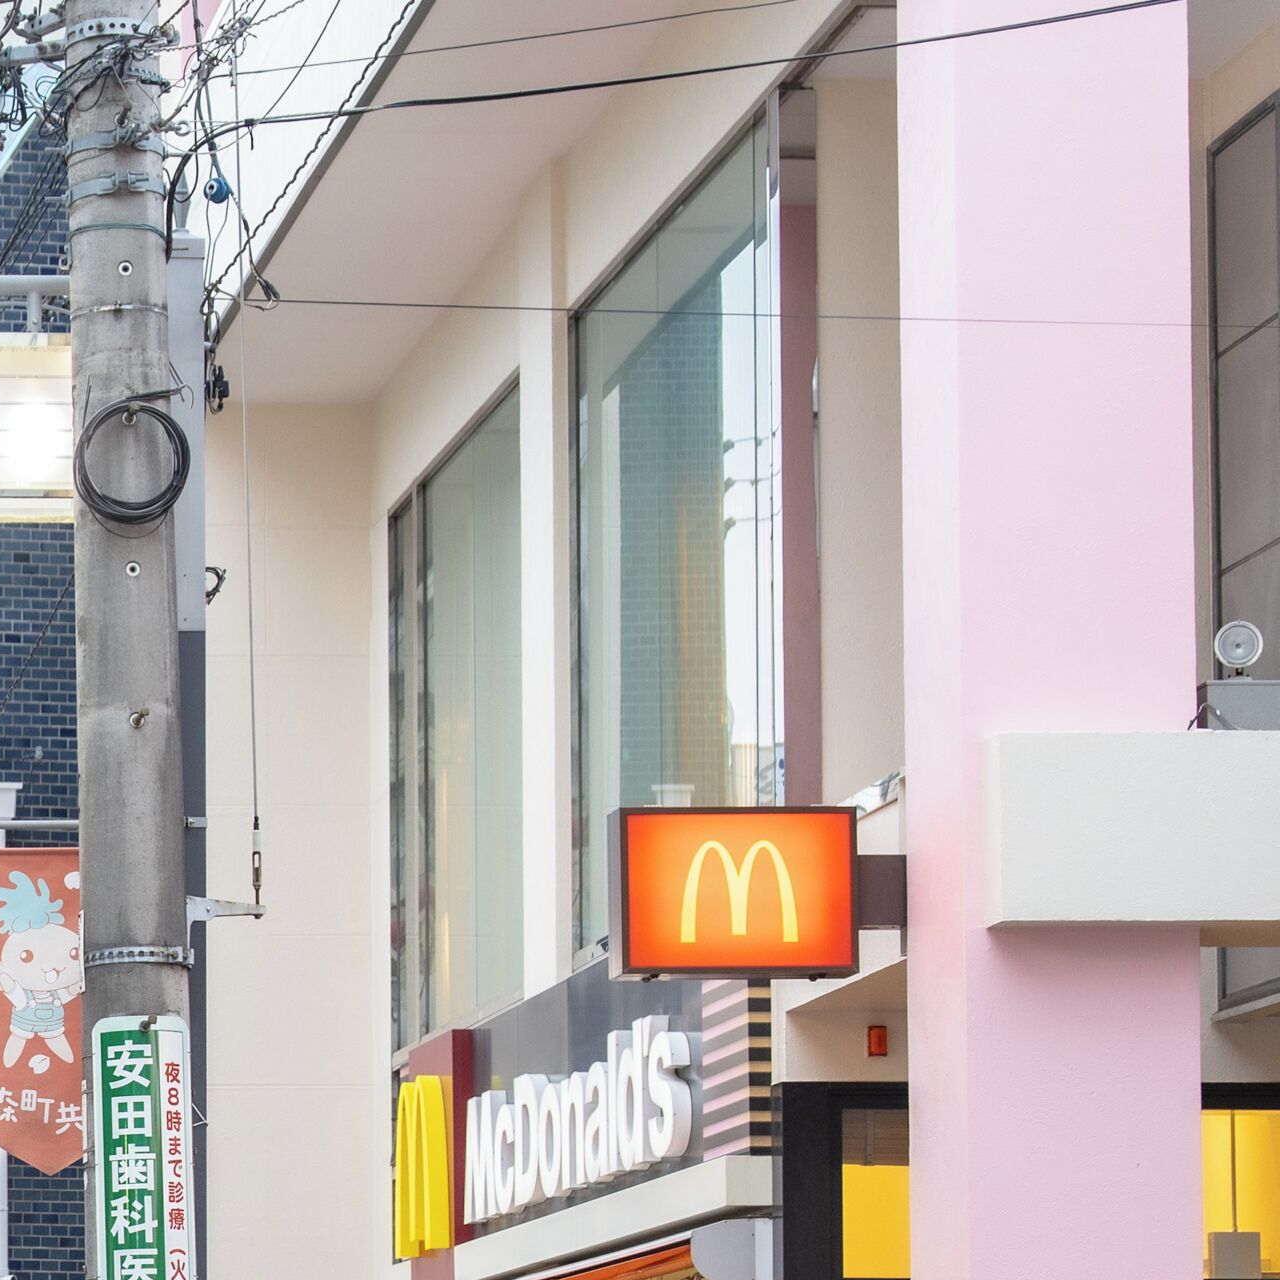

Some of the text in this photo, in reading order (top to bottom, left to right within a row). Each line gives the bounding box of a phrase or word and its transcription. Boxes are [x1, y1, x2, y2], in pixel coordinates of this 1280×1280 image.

[164, 1061, 186, 1231] 夜8時まで診療
[464, 1015, 691, 1224] McDonald's
